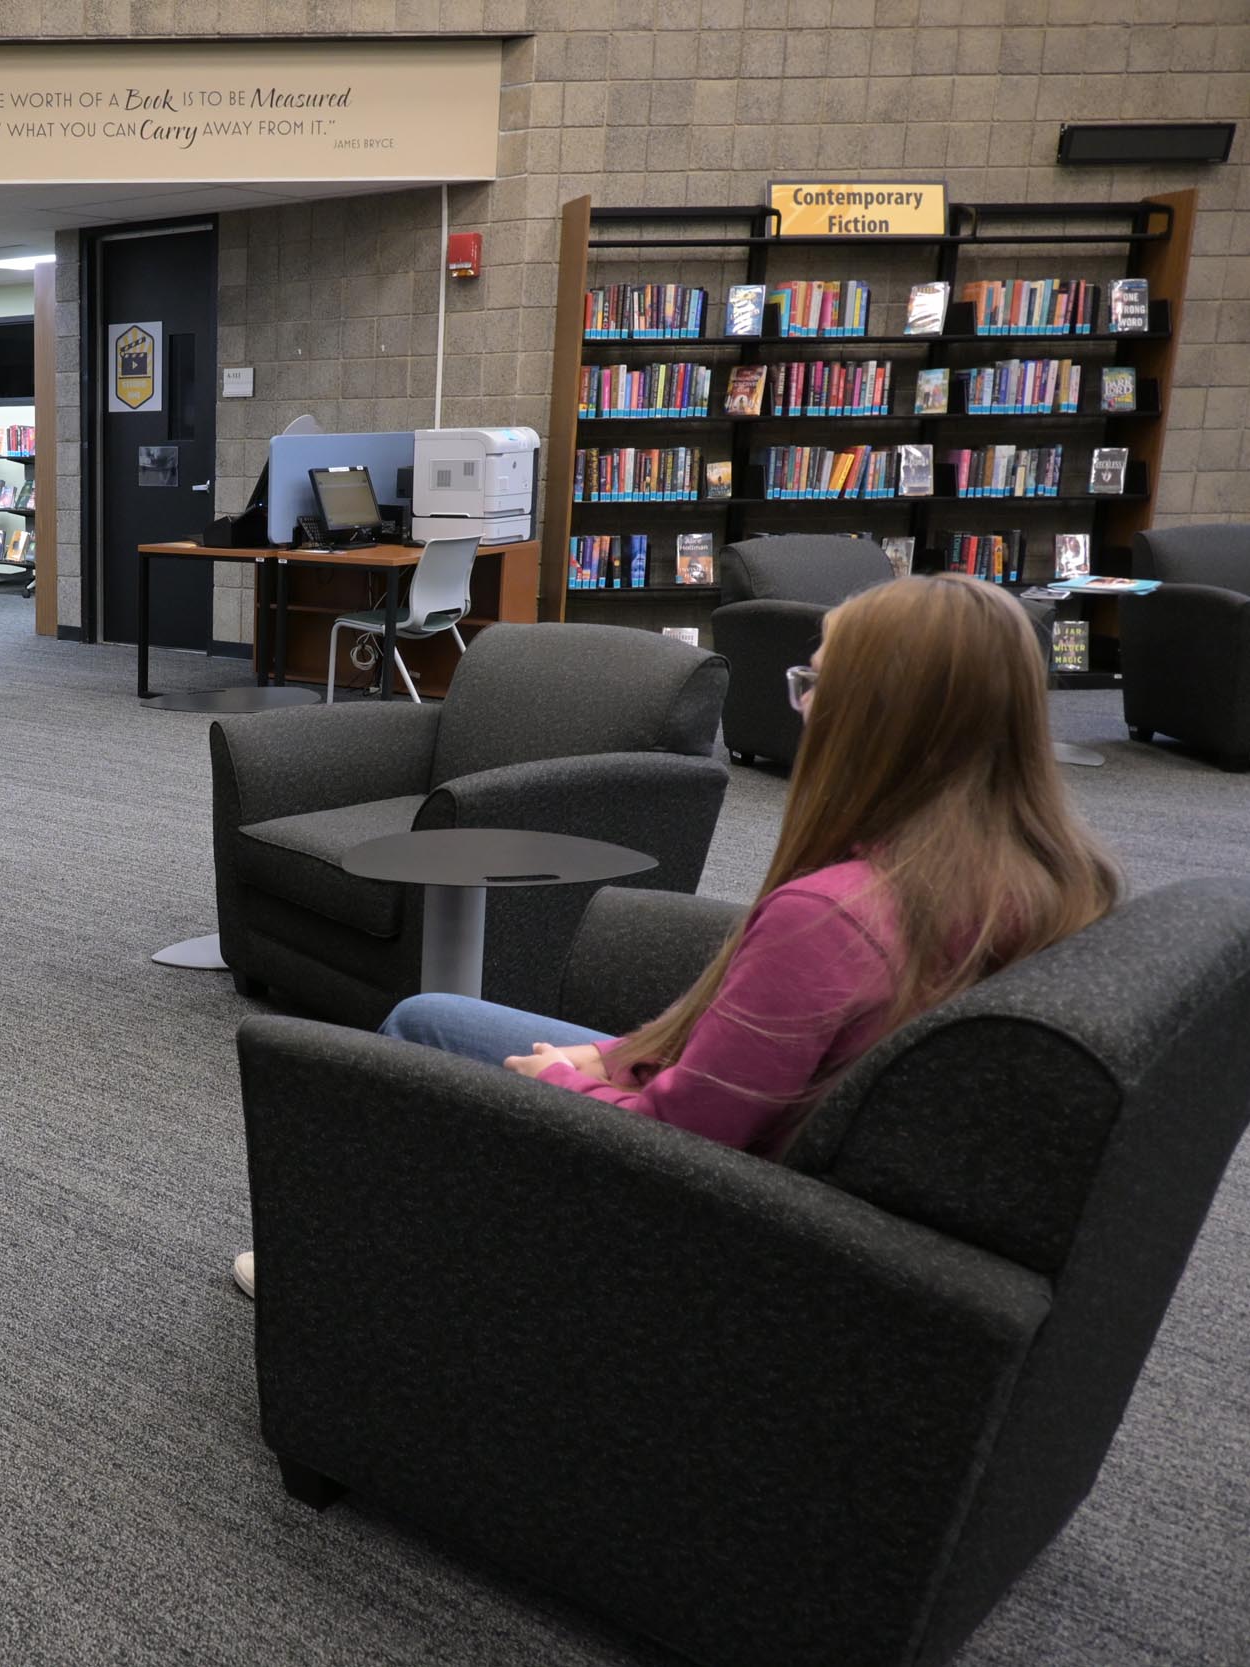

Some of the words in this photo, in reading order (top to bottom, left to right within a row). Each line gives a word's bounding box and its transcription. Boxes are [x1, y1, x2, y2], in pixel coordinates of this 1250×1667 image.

[10, 92, 73, 108] WORTH
[79, 92, 103, 108] OF
[108, 93, 120, 108] A
[125, 88, 179, 113] Book
[182, 91, 194, 106] IS
[199, 91, 222, 106] TO
[229, 91, 246, 106] BE
[250, 87, 352, 109] Measured
[7, 122, 55, 138] WHAT
[60, 121, 96, 138] YOU
[103, 121, 136, 137] CAN
[139, 119, 198, 149] Carry
[202, 121, 252, 136] AWAY
[258, 120, 304, 135] FROM
[333, 138, 361, 149] JAMES
[363, 138, 395, 149] BRYCE
[793, 188, 923, 210] Contemporary
[828, 215, 889, 233] Fiction
[1123, 292, 1139, 301] ONE
[1054, 656, 1083, 664] MAGIC
